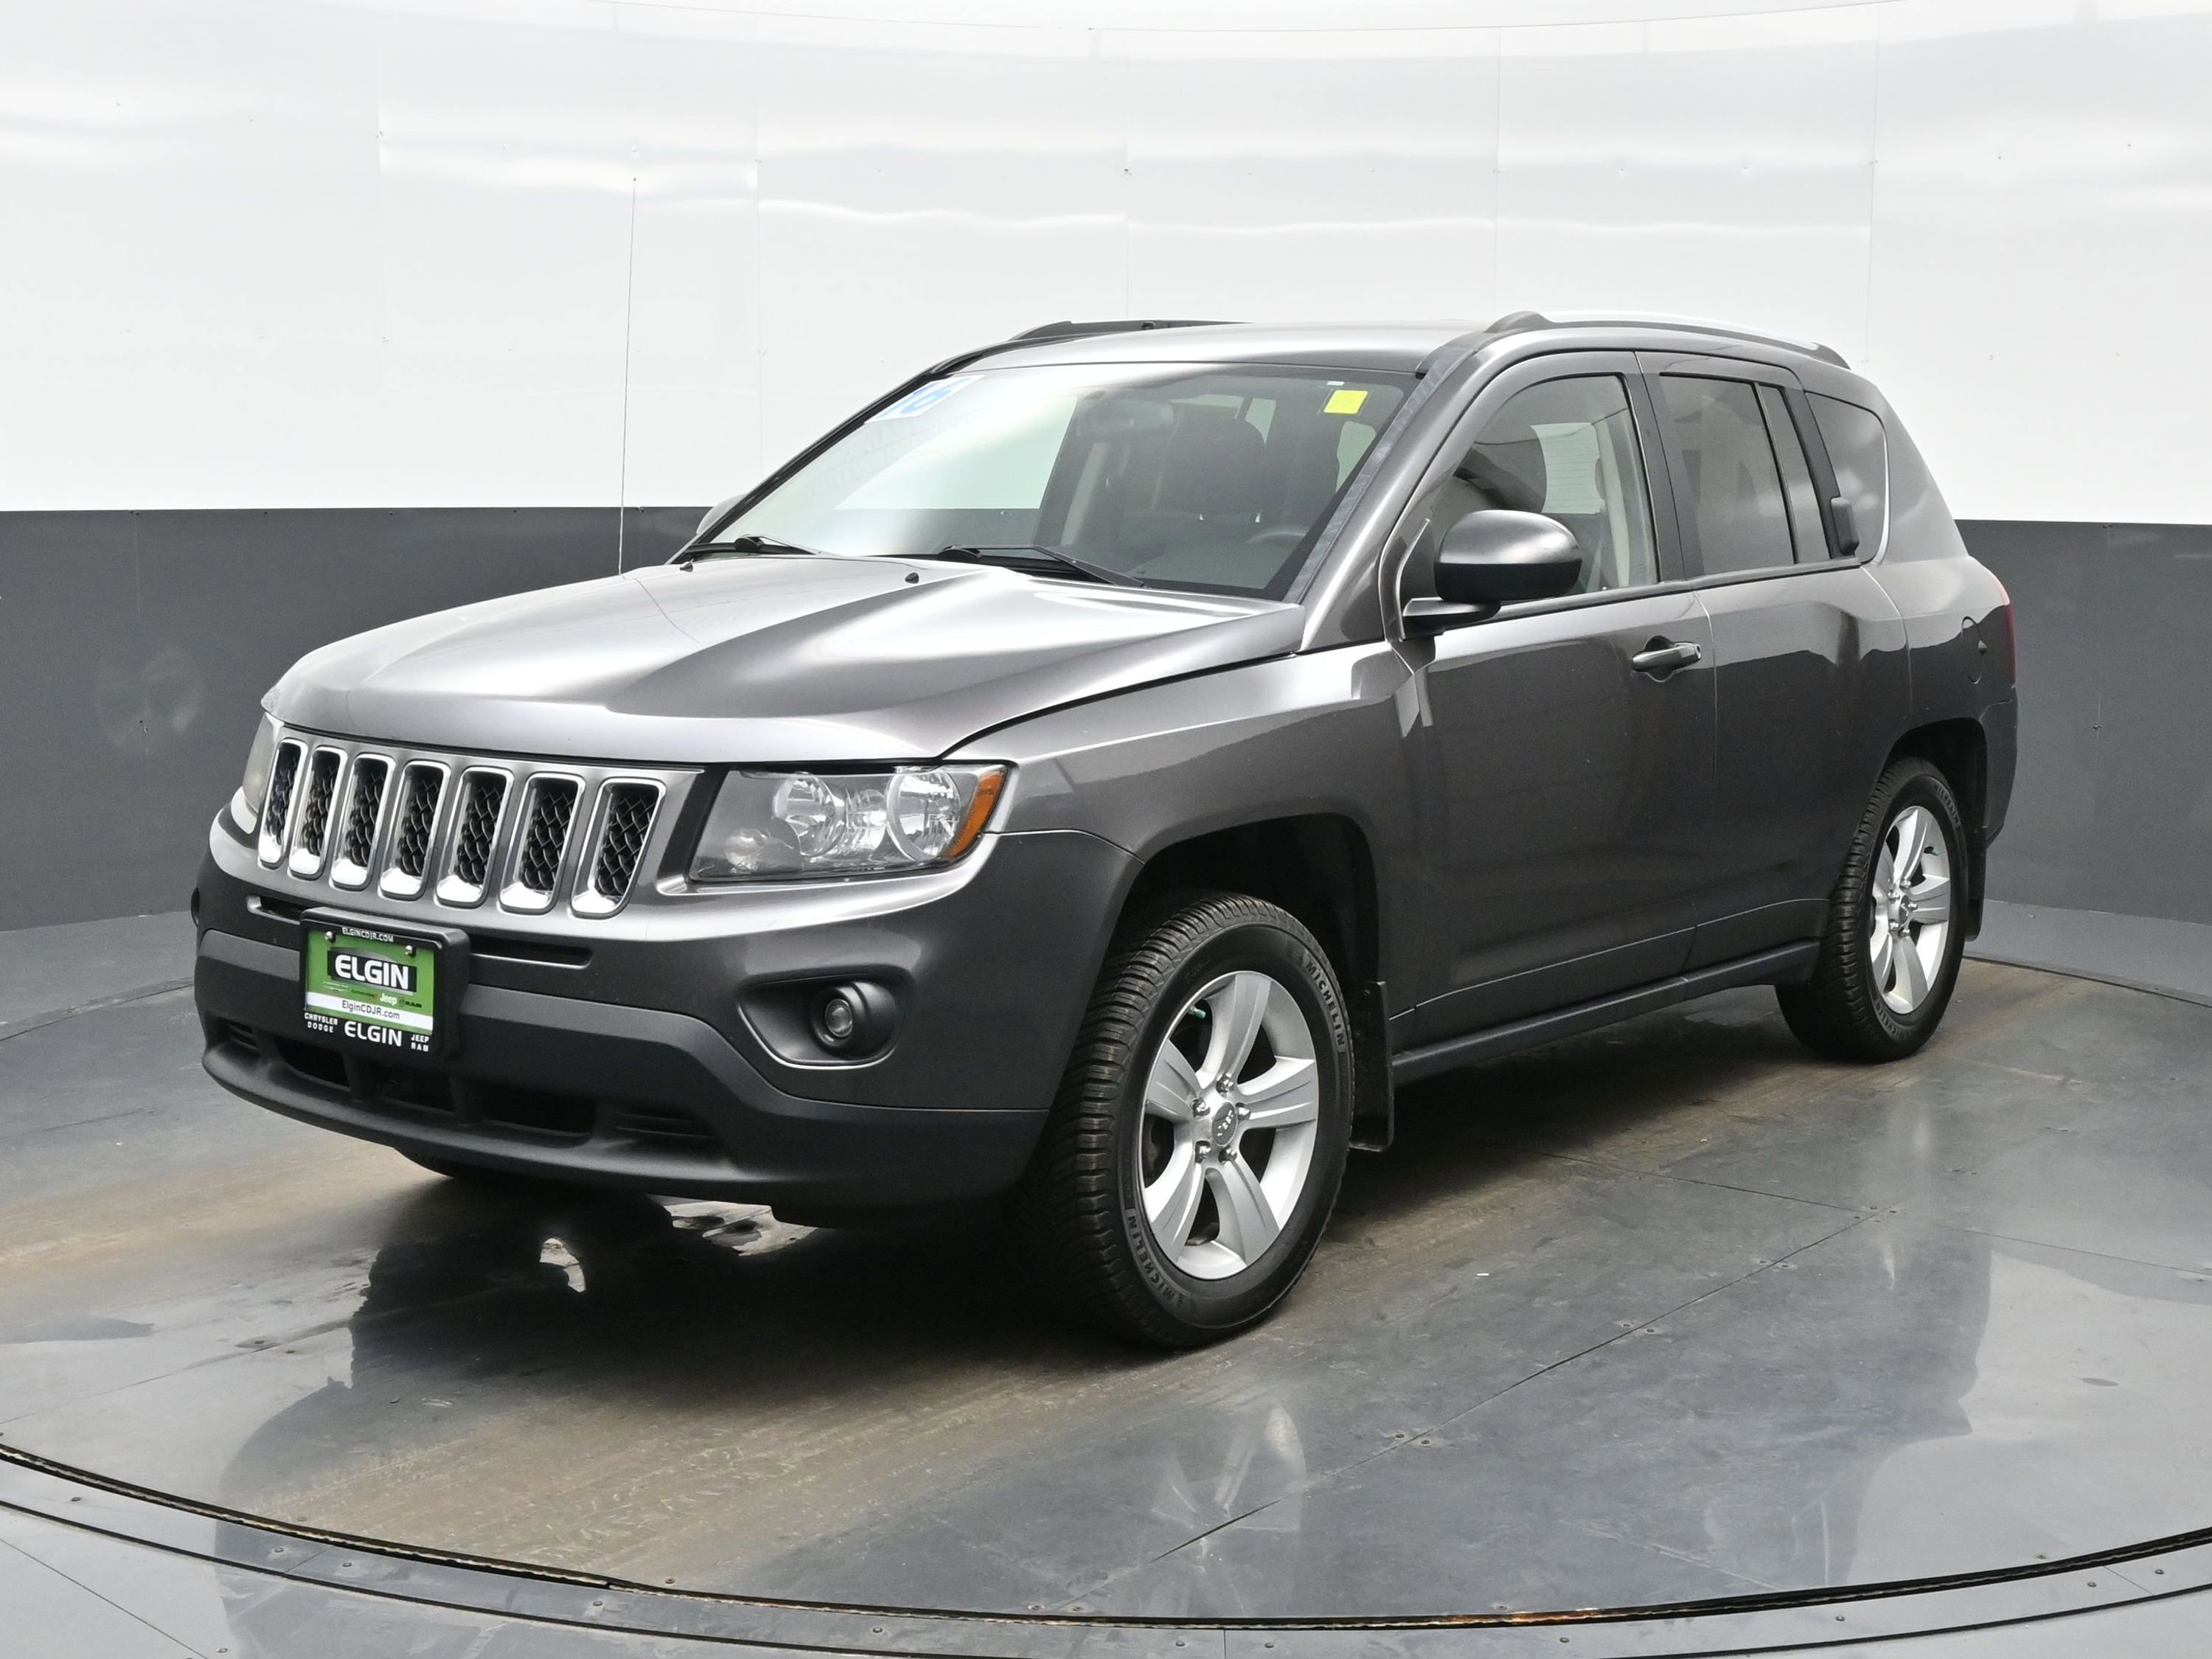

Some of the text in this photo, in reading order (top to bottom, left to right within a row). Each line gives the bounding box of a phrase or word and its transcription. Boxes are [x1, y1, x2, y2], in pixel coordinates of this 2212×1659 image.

[342, 927, 394, 943] ELGINCDJR.COM
[335, 954, 409, 990] ELGIN
[380, 992, 397, 1006] Jeep
[1305, 961, 1346, 1046] MICHELIN
[341, 1000, 400, 1020] ElginCDJR.com
[304, 1012, 338, 1026] CHRYSLER
[307, 1021, 334, 1033] DODGE
[344, 1020, 402, 1047] ELGIN
[411, 1034, 430, 1043] JEEP
[411, 1042, 429, 1052] RAM
[1127, 1215, 1175, 1302] MICHELIN
